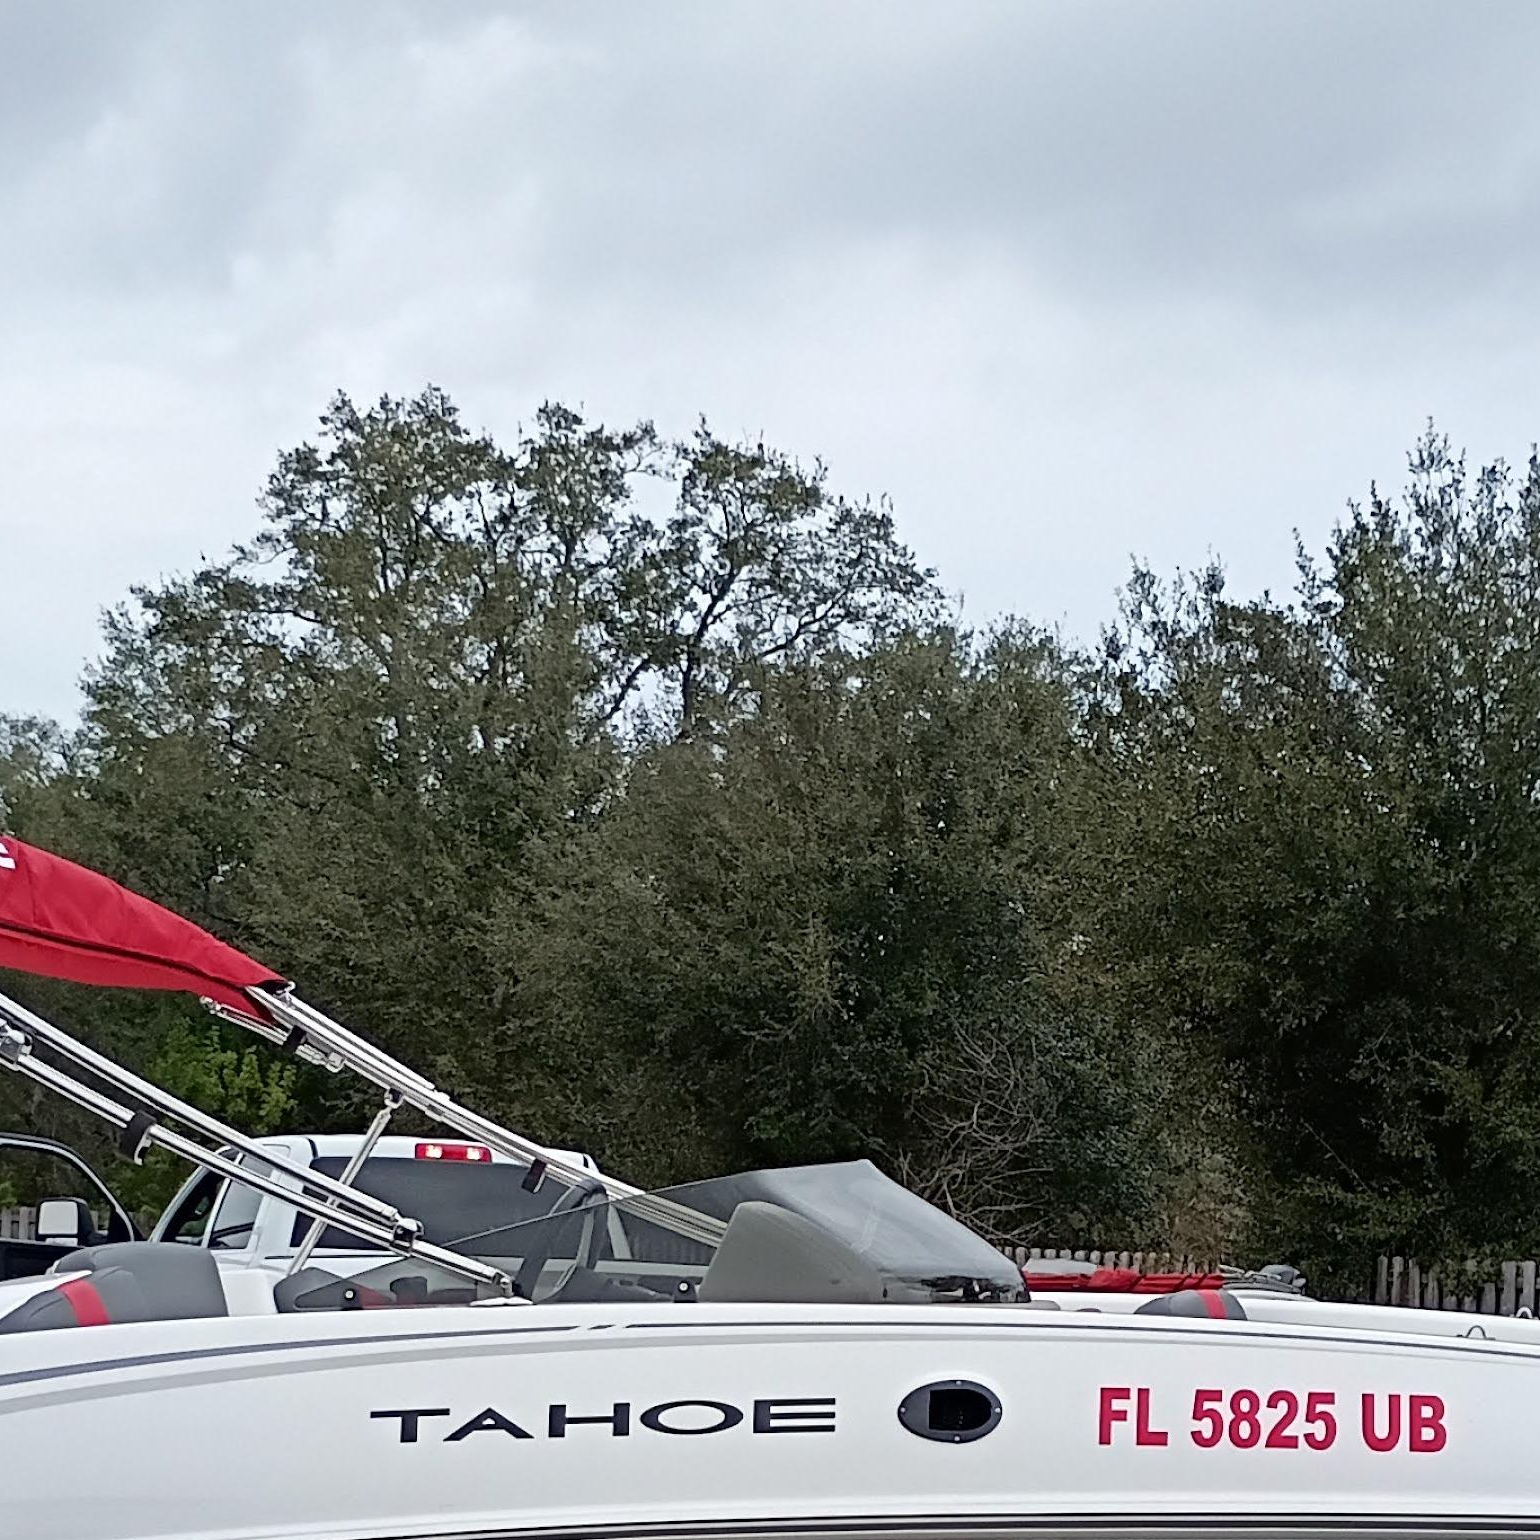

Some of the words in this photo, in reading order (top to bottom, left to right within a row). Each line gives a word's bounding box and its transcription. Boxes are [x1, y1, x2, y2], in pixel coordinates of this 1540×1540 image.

[369, 1397, 837, 1444] TAHOE
[1097, 1386, 1170, 1448] FL
[1190, 1388, 1339, 1452] 5825
[1361, 1392, 1448, 1454] UB
